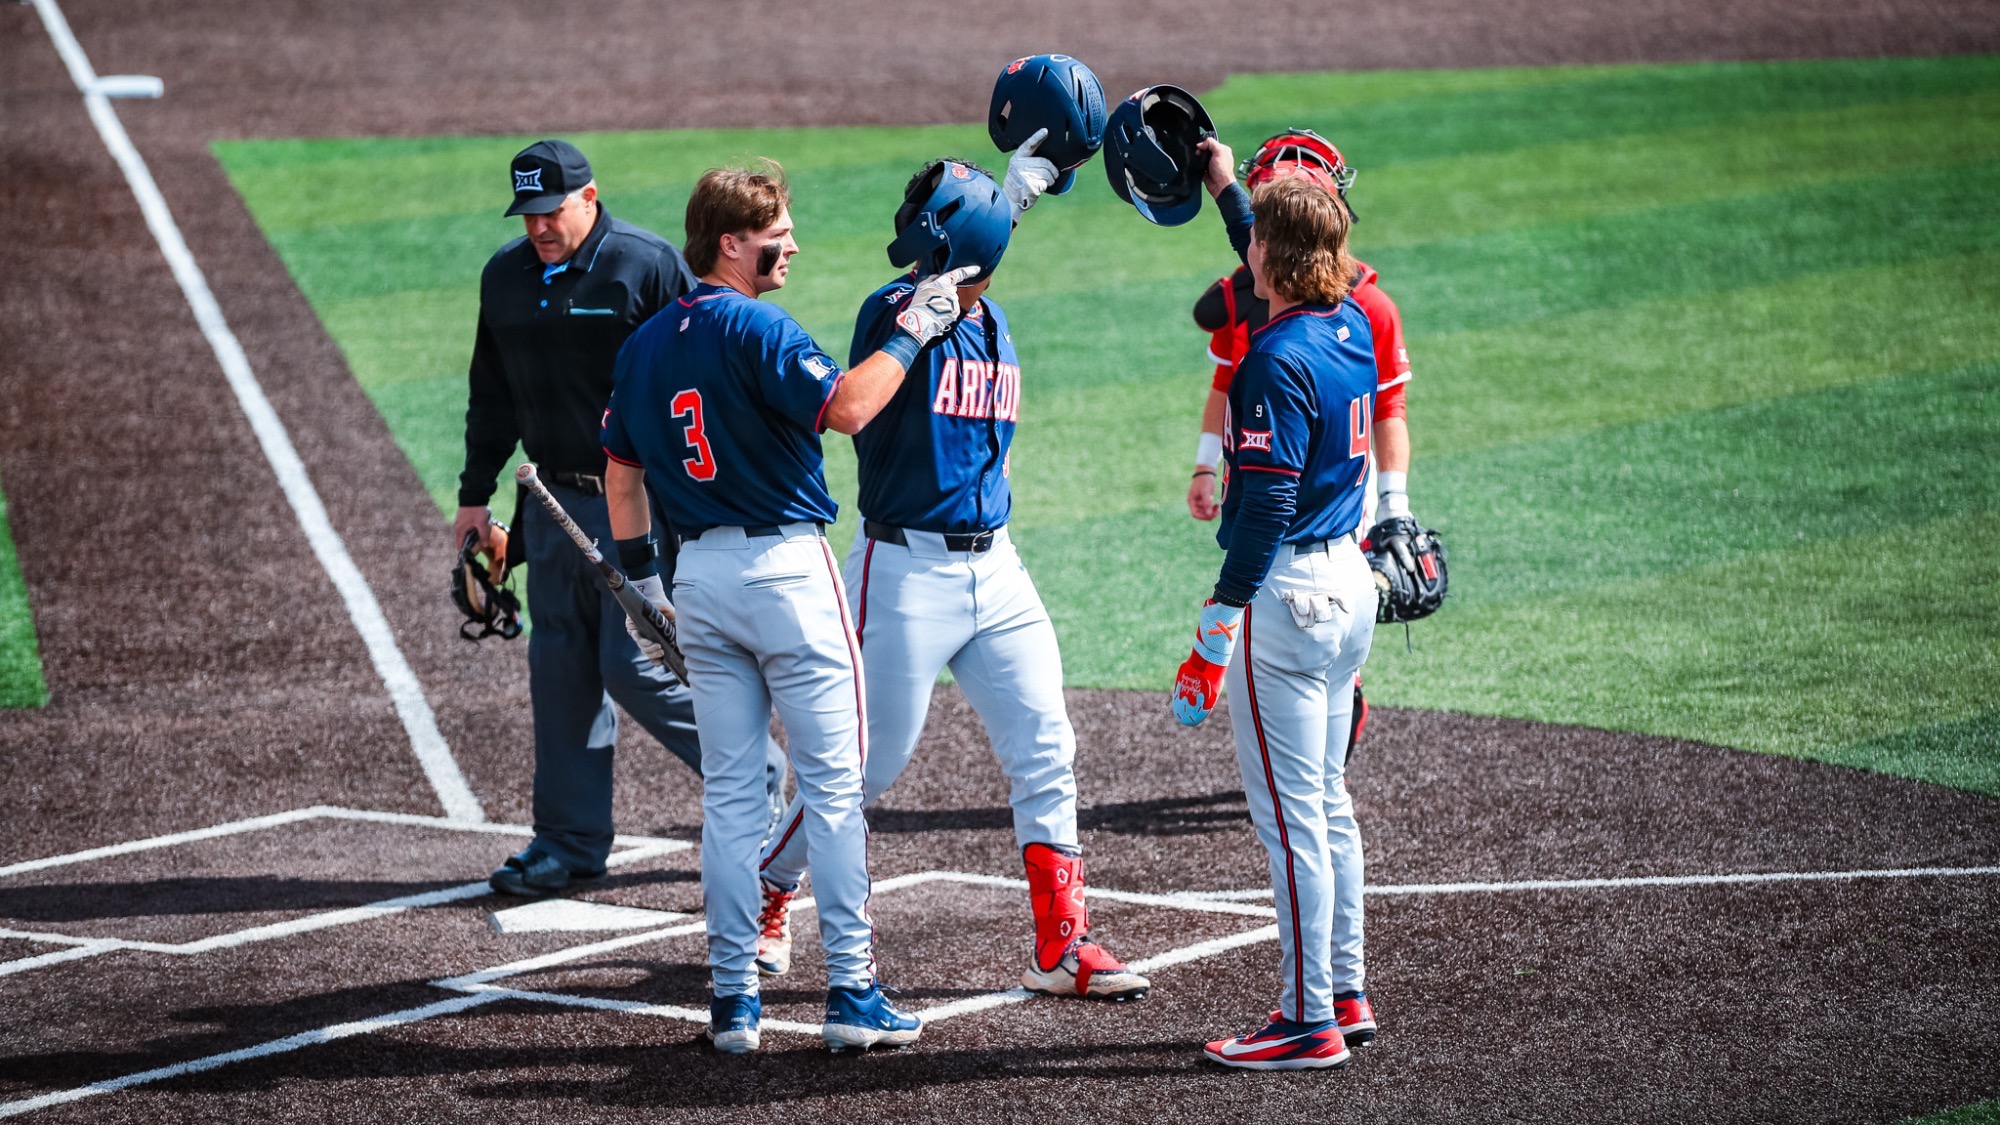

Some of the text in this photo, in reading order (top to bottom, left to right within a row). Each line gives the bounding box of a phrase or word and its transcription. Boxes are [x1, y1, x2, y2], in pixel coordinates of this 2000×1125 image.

[670, 387, 717, 482] 3
[1255, 404, 1263, 418] 9
[1349, 391, 1371, 487] 4
